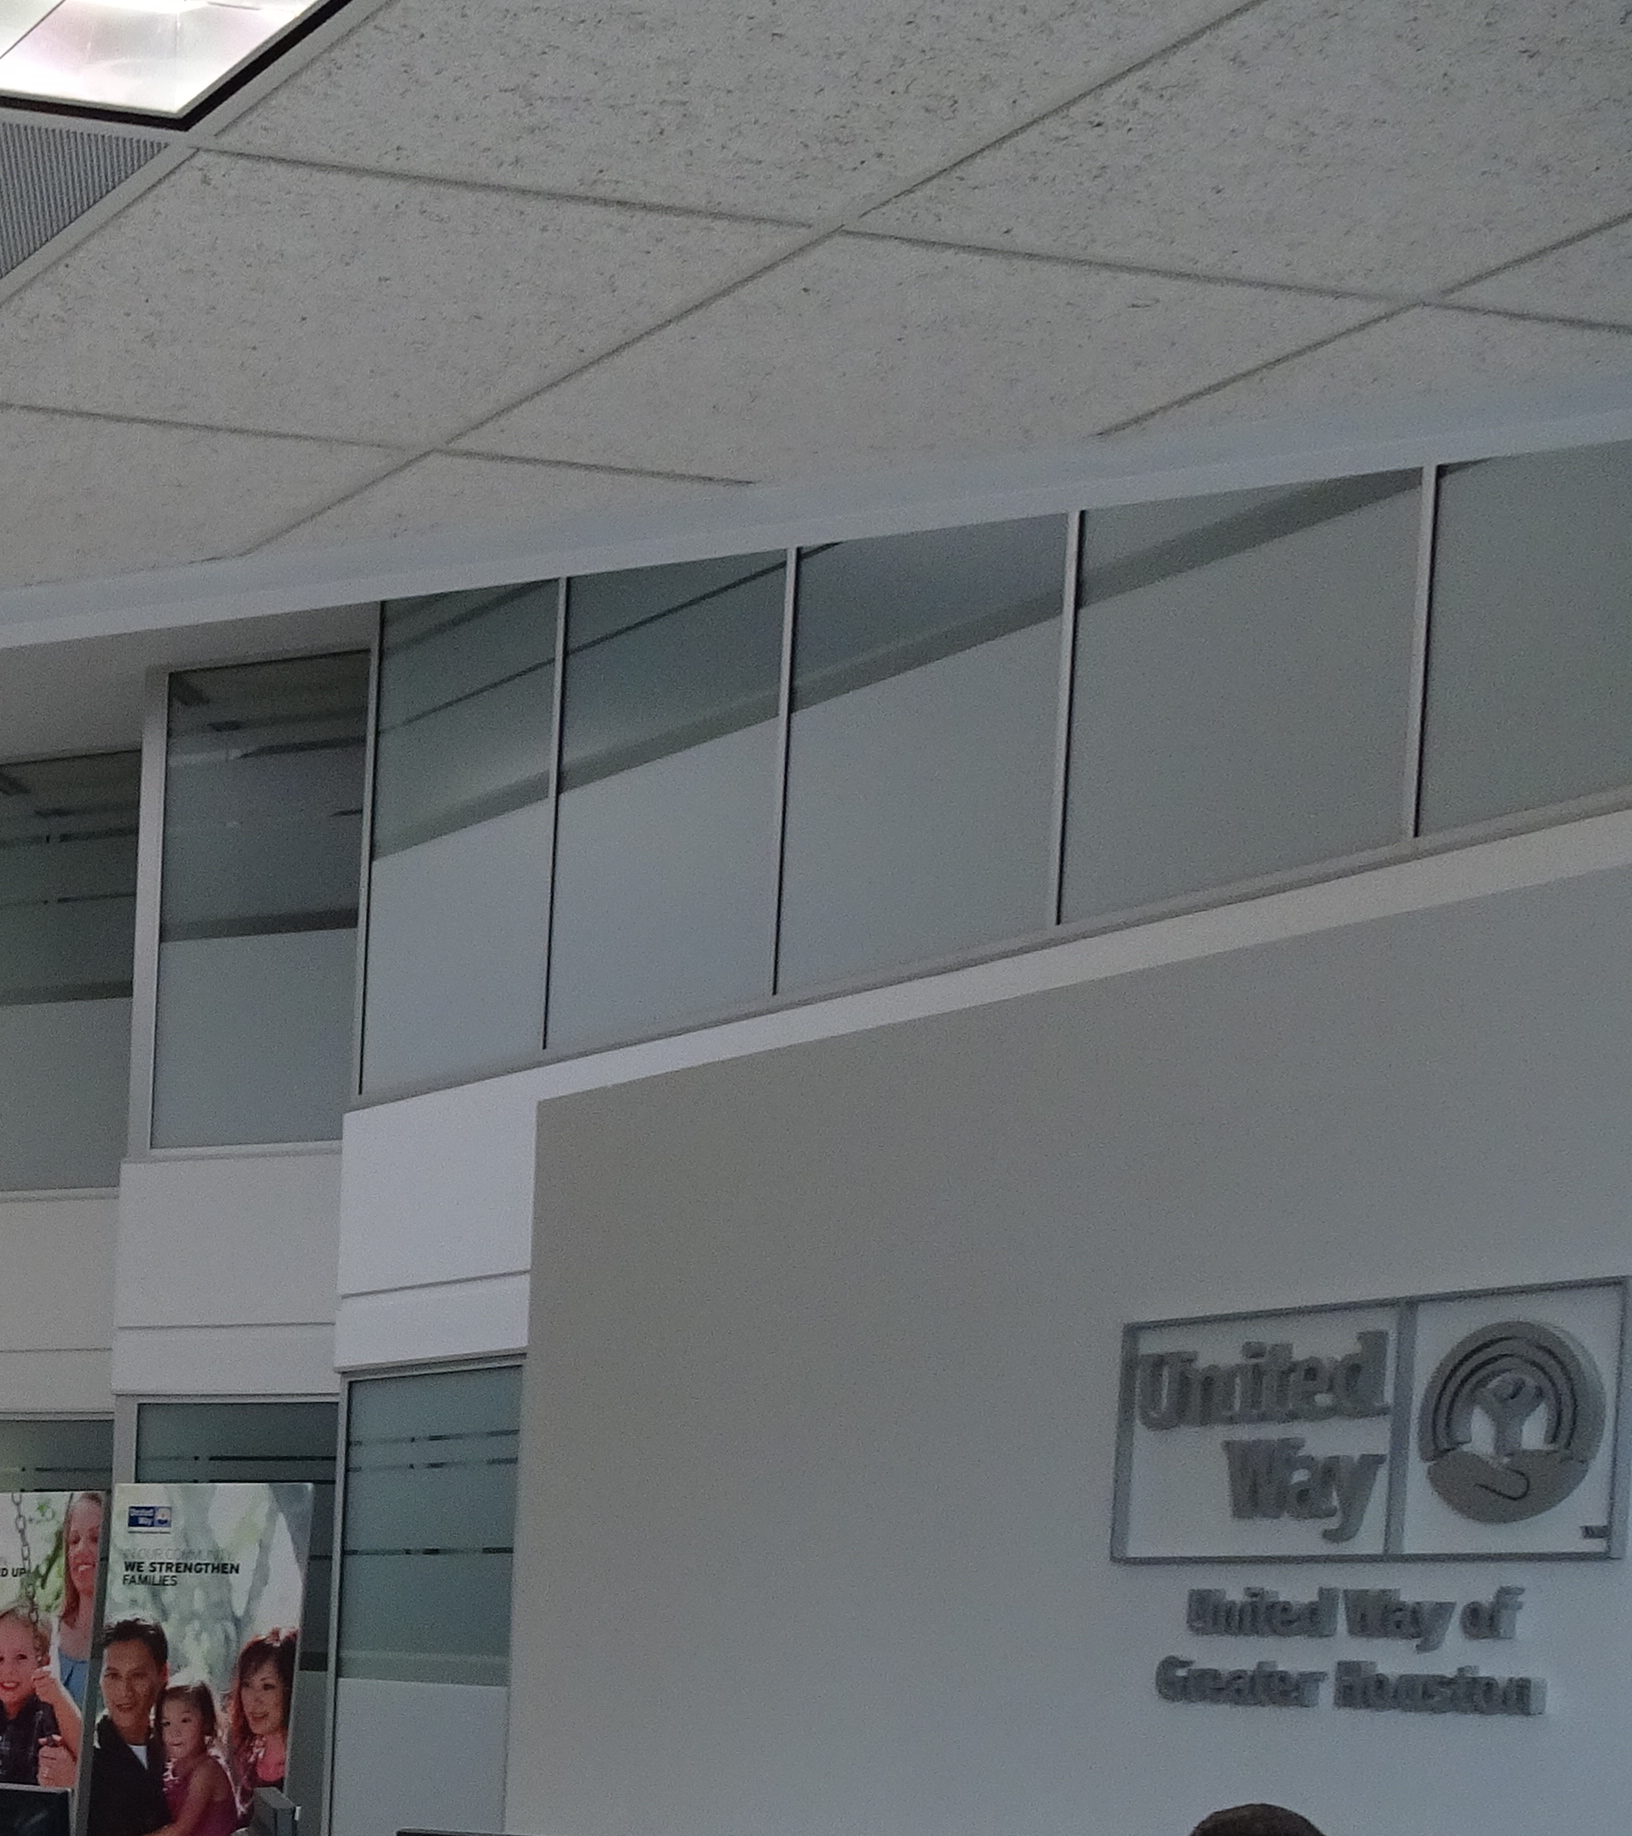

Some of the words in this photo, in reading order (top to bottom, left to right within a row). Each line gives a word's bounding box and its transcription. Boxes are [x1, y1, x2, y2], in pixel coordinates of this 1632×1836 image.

[1138, 1331, 1389, 1431] United
[1222, 1437, 1387, 1543] Way
[11, 1567, 27, 1577] UP
[122, 1574, 178, 1586] FAMILIES
[124, 1561, 145, 1573] WE
[148, 1562, 240, 1574] STRENGTHEN
[1186, 1585, 1339, 1637] United
[1343, 1587, 1457, 1653] Way
[1459, 1585, 1525, 1639] of
[1155, 1655, 1329, 1708] Greater
[1334, 1659, 1548, 1716] Houston
